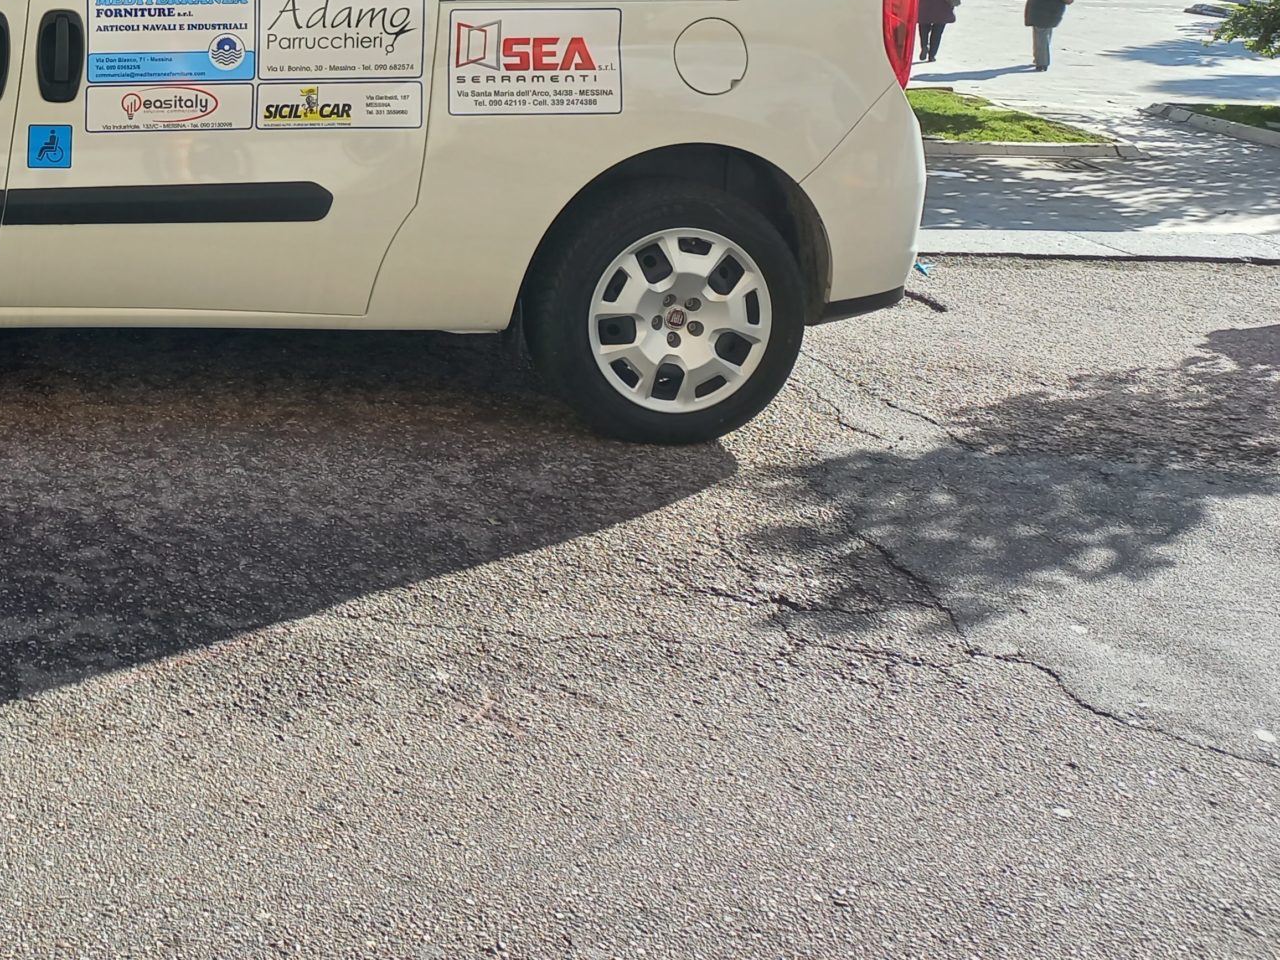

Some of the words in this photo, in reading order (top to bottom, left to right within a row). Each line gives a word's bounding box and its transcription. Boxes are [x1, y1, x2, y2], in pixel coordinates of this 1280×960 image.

[95, 8, 176, 18] FORNITURE
[95, 24, 140, 32] ARTICOLI
[142, 23, 176, 31] NAVALI
[177, 23, 185, 31] E
[187, 23, 248, 31] INDUSTRIALI
[266, 32, 383, 50] Parrucchieri
[502, 37, 596, 71] SEA
[456, 75, 597, 84] SERRAMENTI
[143, 94, 209, 113] easitaly
[488, 99, 503, 107] 090
[264, 103, 302, 119] SICIL
[320, 103, 352, 119] CAR
